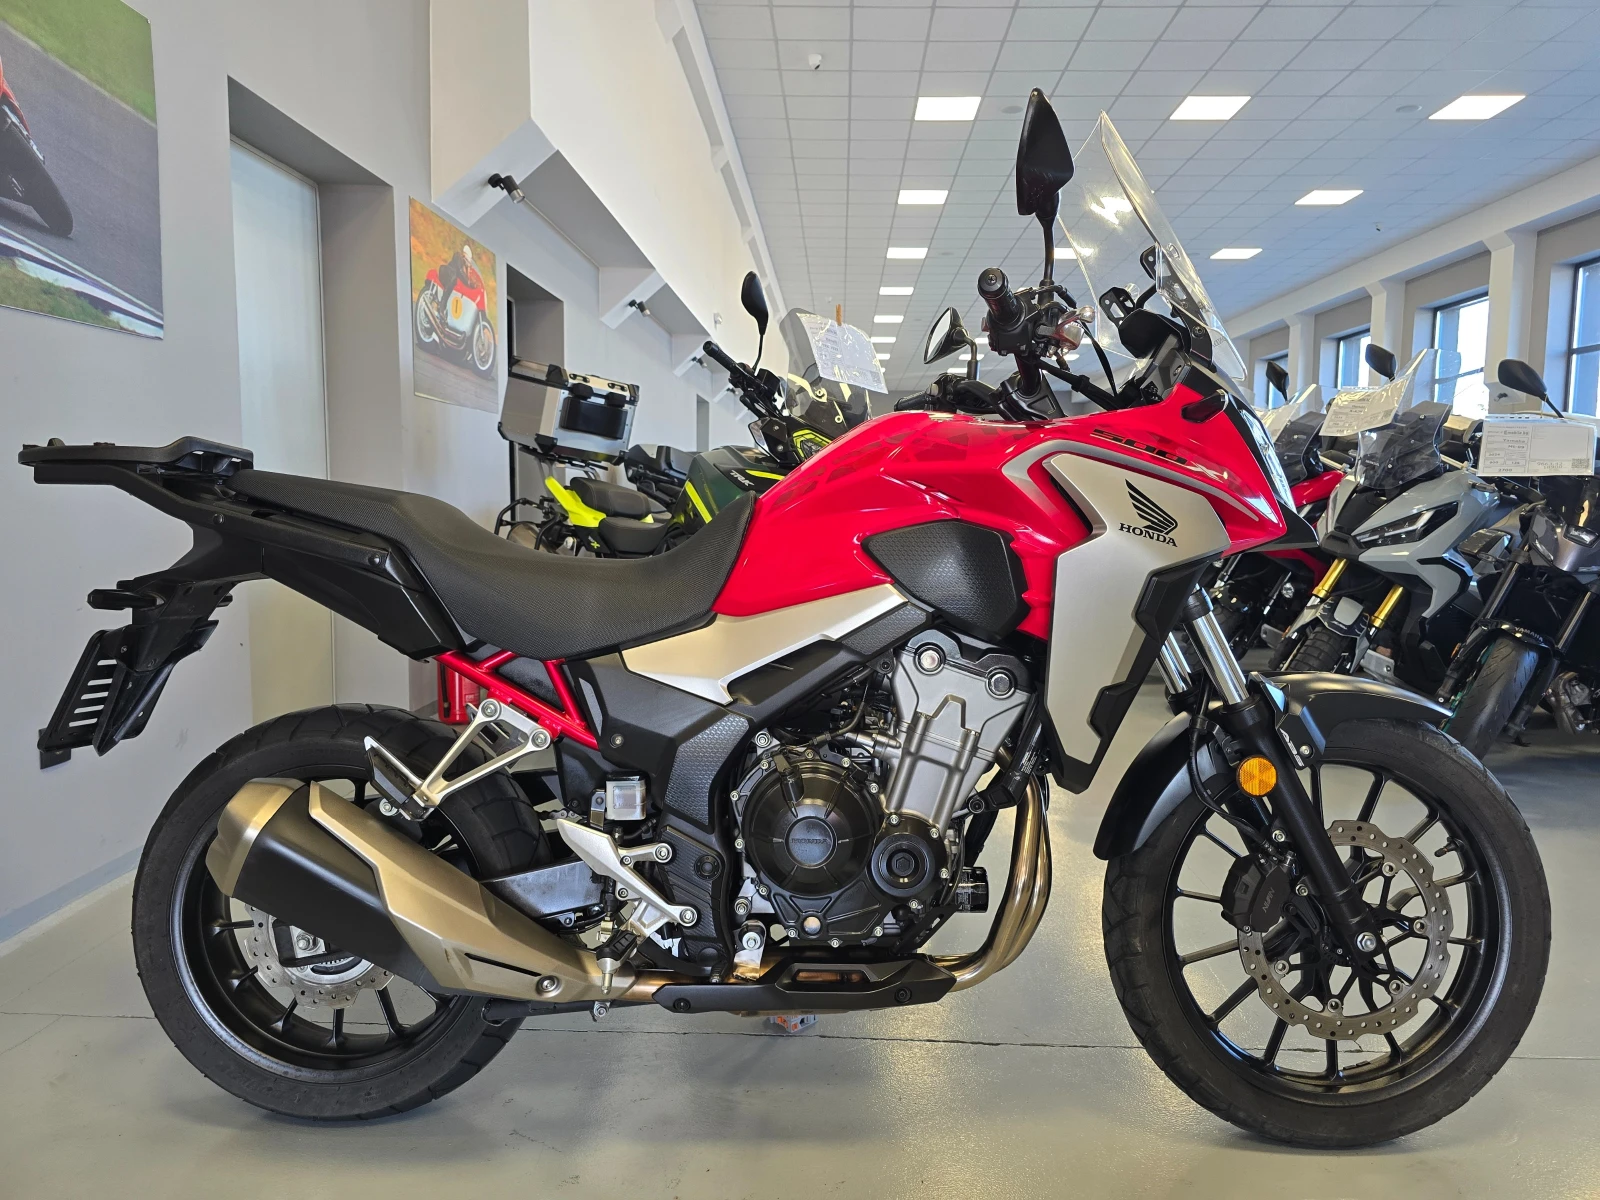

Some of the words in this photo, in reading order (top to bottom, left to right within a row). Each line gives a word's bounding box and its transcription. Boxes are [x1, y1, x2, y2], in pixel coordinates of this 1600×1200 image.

[1118, 522, 1178, 547] HONDA
[1514, 626, 1544, 642] YAMAHA
[791, 837, 829, 845] HONDA
